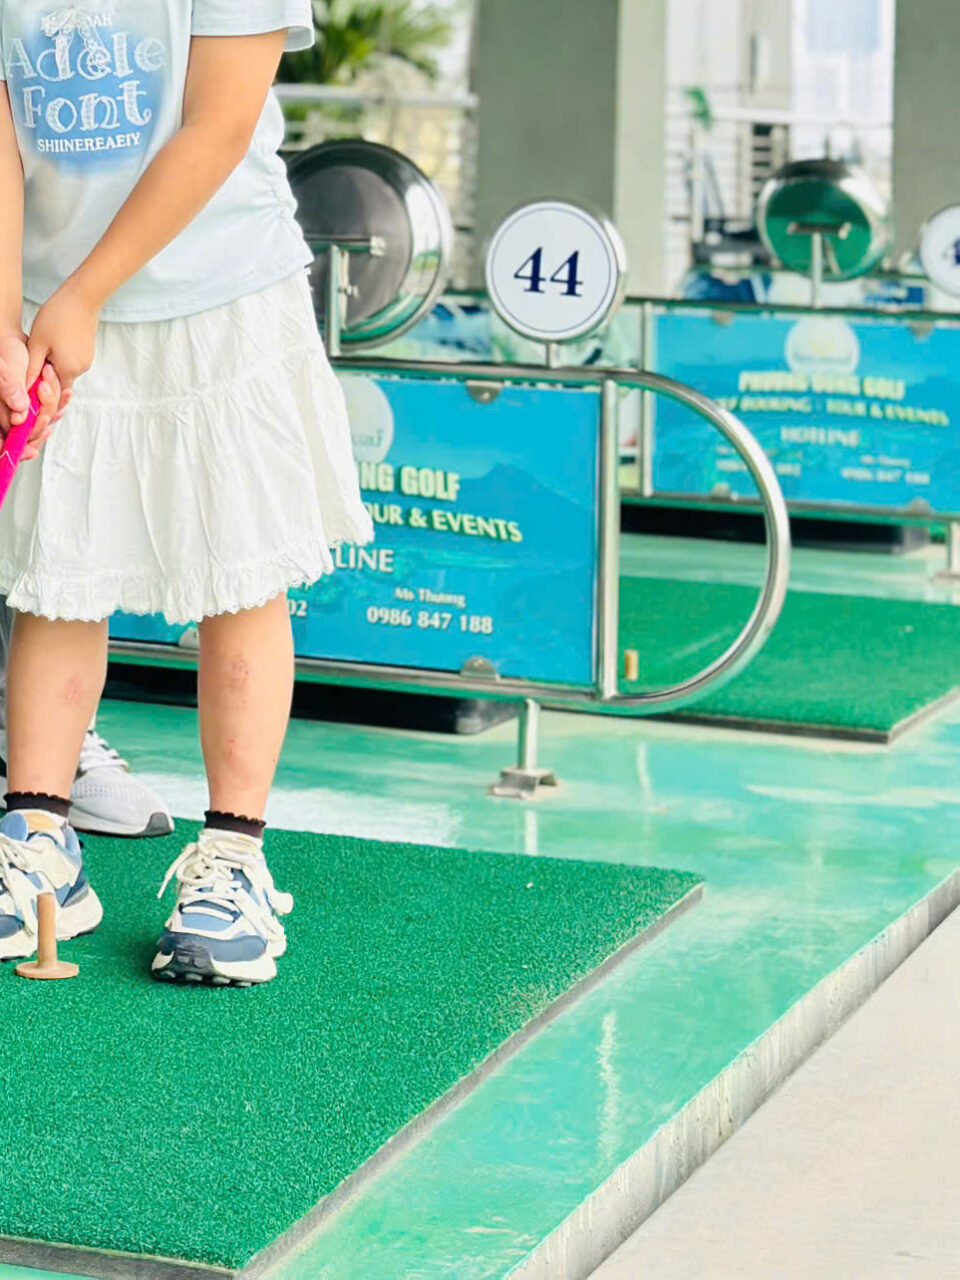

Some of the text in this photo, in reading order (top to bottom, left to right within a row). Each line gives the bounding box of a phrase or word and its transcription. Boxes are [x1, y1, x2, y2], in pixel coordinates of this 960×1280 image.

[23, 80, 152, 133] Font
[513, 246, 584, 298] 44
[399, 465, 460, 502] GOLF
[409, 506, 428, 529] &
[431, 509, 524, 543] EVENTS
[366, 606, 494, 635] 0986 847 188
